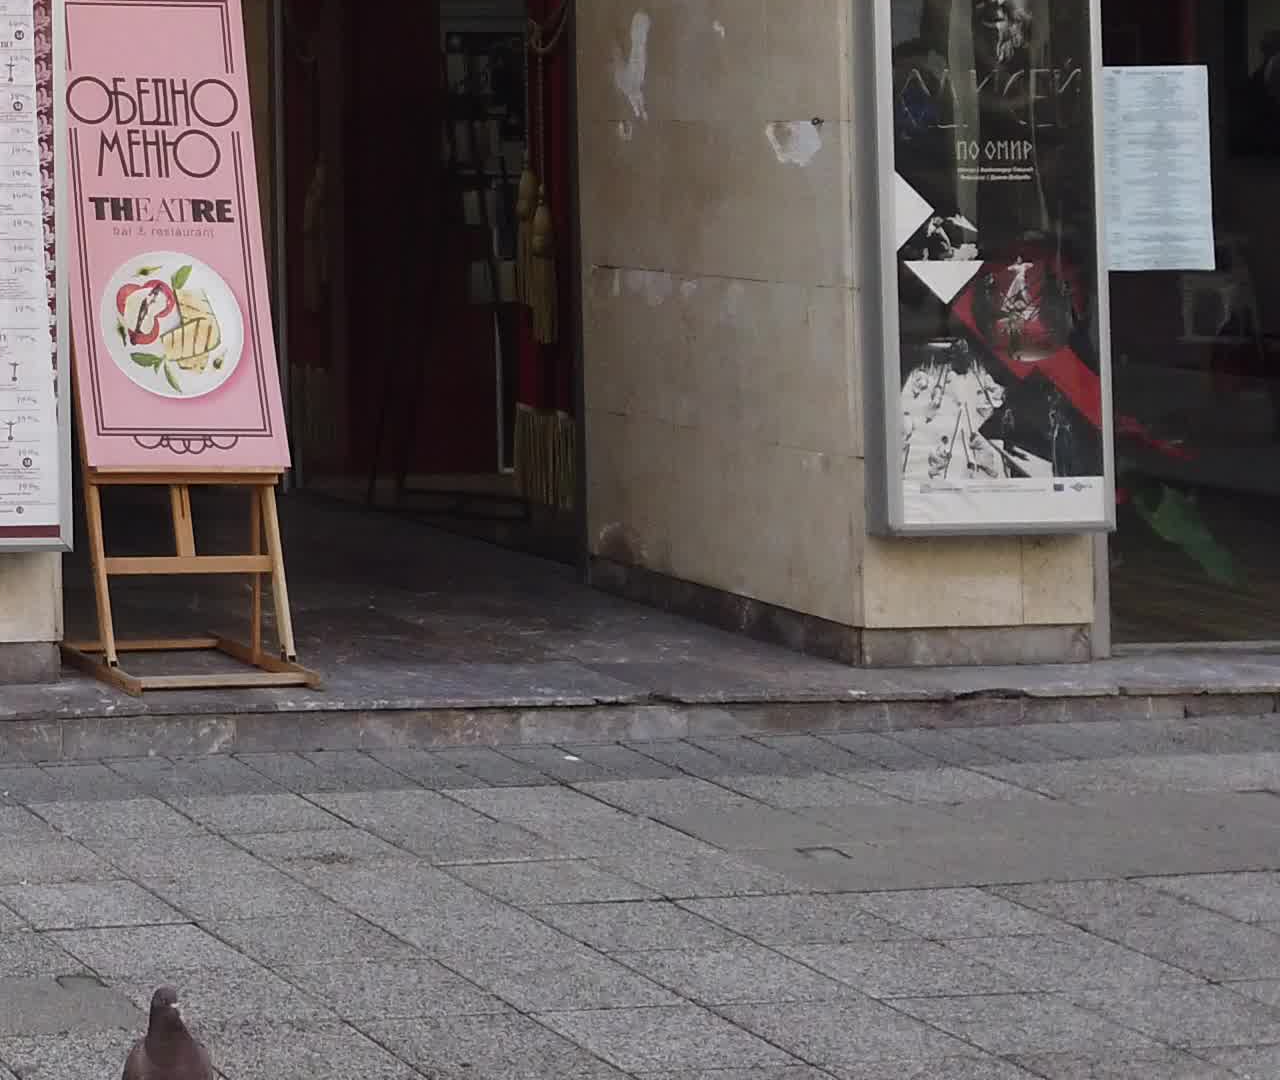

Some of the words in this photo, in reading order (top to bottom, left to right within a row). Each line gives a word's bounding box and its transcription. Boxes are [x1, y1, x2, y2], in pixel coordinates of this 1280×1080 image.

[66, 76, 238, 127] ОБЕДНО
[97, 129, 221, 179] МЕНЮ
[956, 140, 980, 160] ПО
[985, 140, 1033, 160] ОМИР
[88, 196, 235, 224] THEATRE
[113, 226, 133, 237] bar
[151, 226, 215, 239] restaurant
